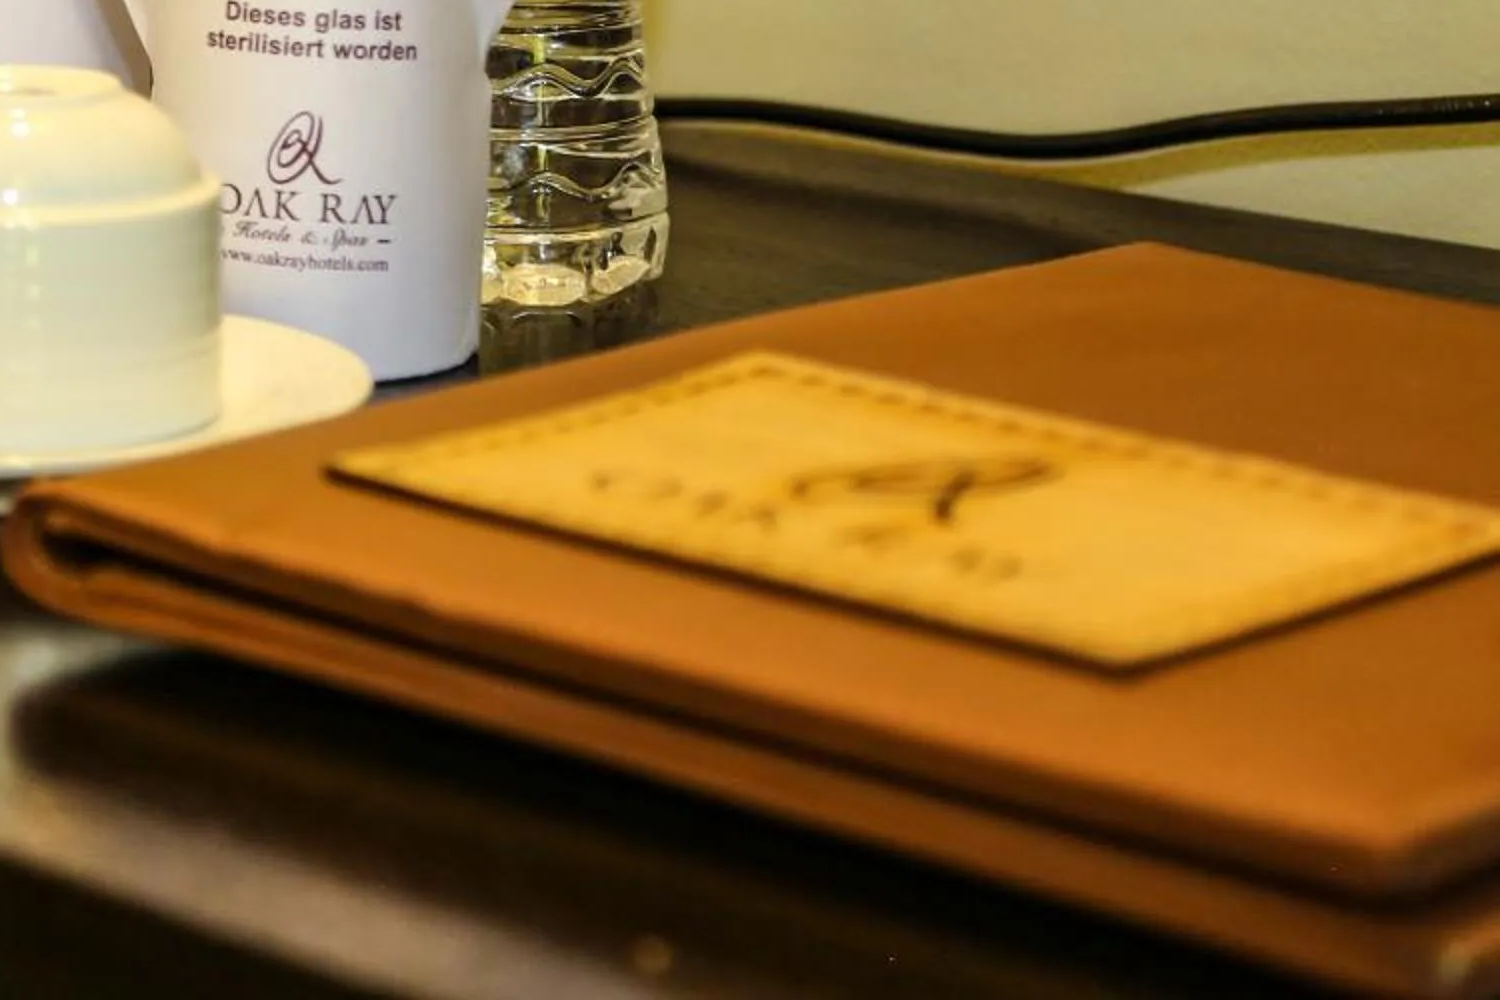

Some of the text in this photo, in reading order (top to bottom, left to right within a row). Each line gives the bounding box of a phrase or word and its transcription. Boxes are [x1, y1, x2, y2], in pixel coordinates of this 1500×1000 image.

[224, 0, 402, 34] Dieses glas ist
[206, 28, 418, 62] sterilisiert worden
[319, 192, 399, 225] RAY
